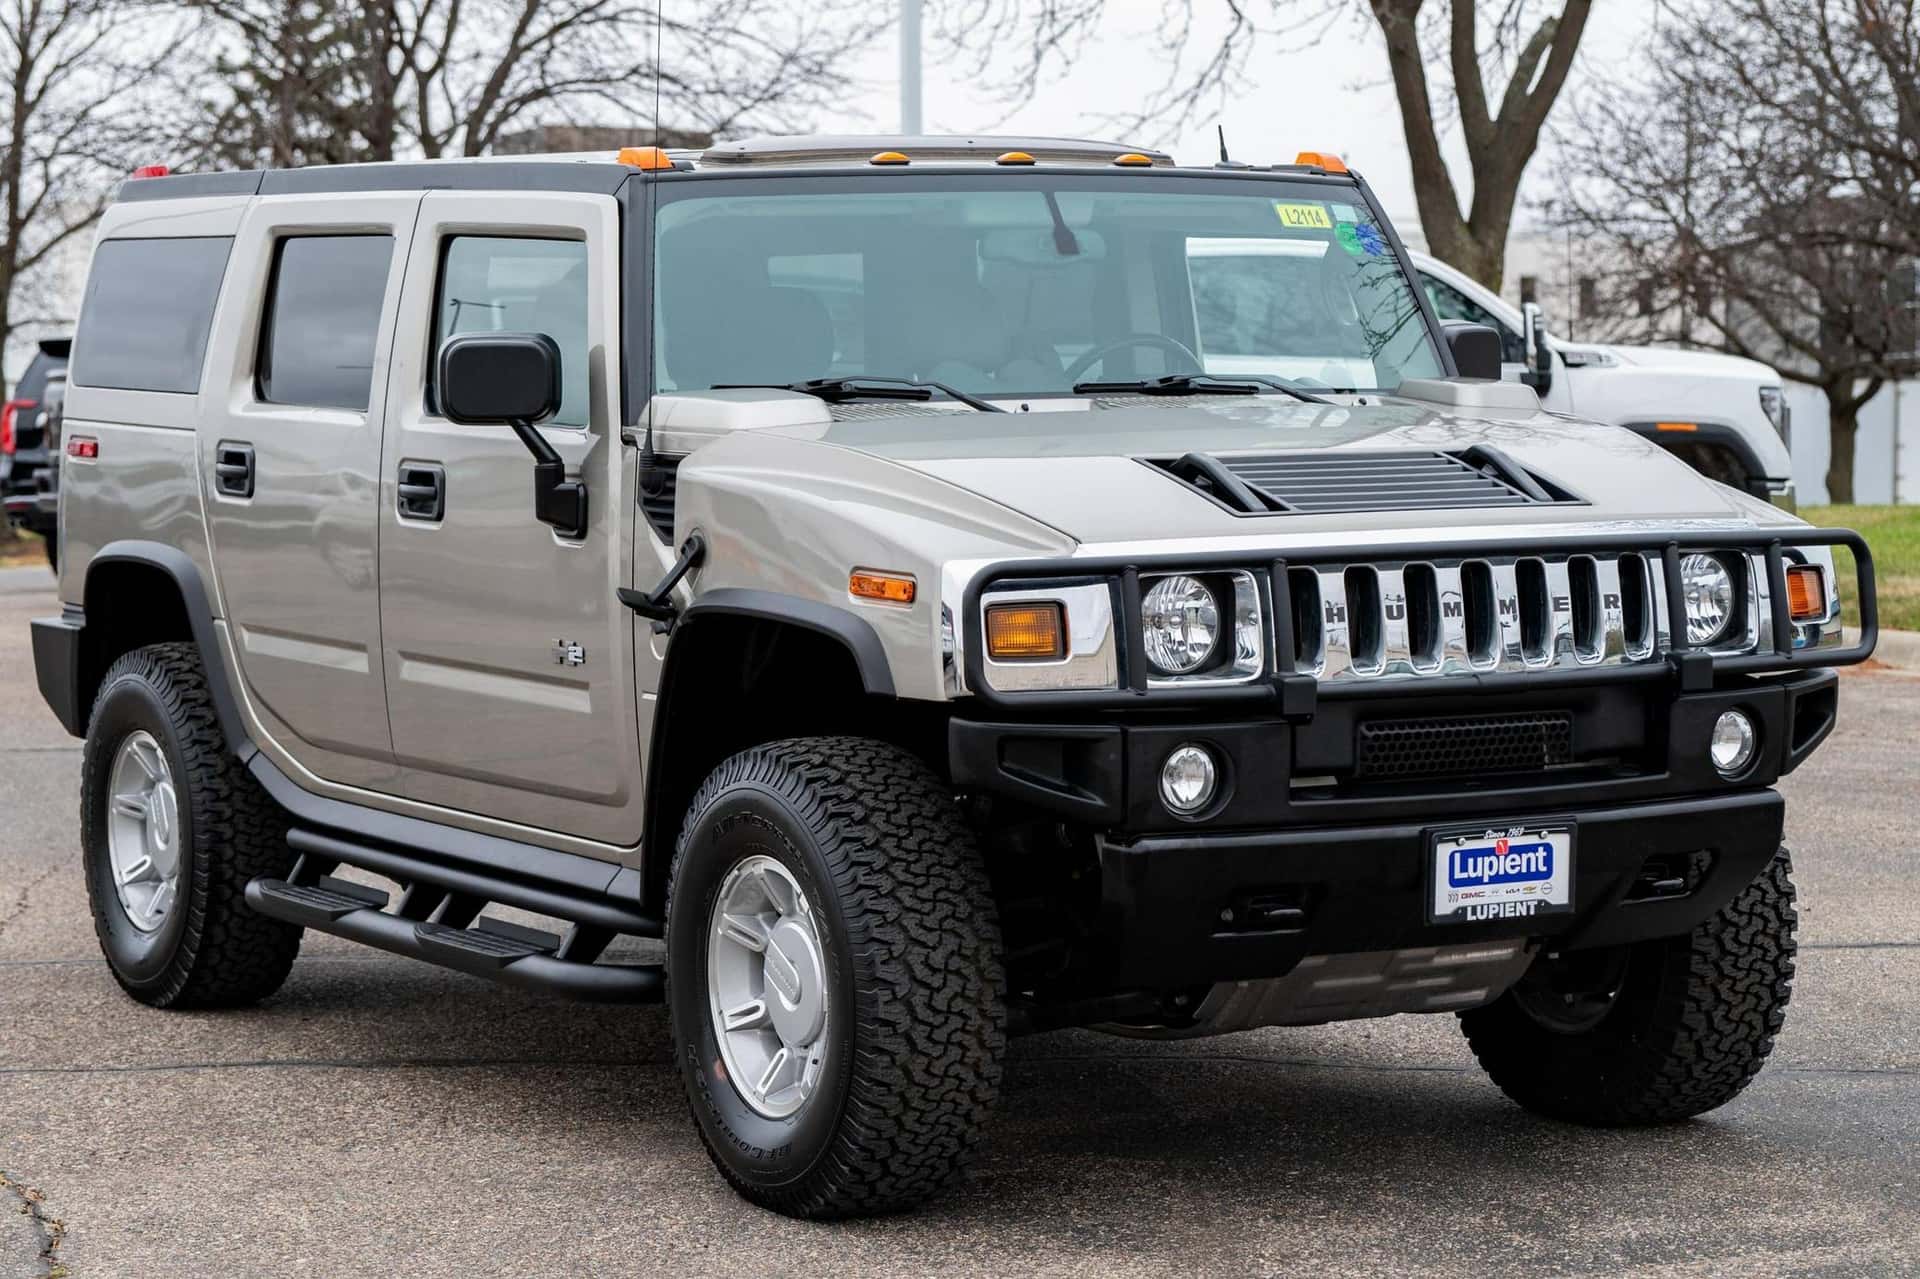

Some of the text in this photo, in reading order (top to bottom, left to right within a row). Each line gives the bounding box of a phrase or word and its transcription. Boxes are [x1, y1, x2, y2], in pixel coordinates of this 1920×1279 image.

[1284, 207, 1324, 226] L2114
[1325, 593, 1621, 624] HUMMER
[551, 638, 586, 667] H2
[1484, 830, 1505, 840] Since
[1453, 846, 1548, 883] Lupient
[1461, 891, 1487, 900] GMC
[1466, 900, 1538, 921] LUPIENT
